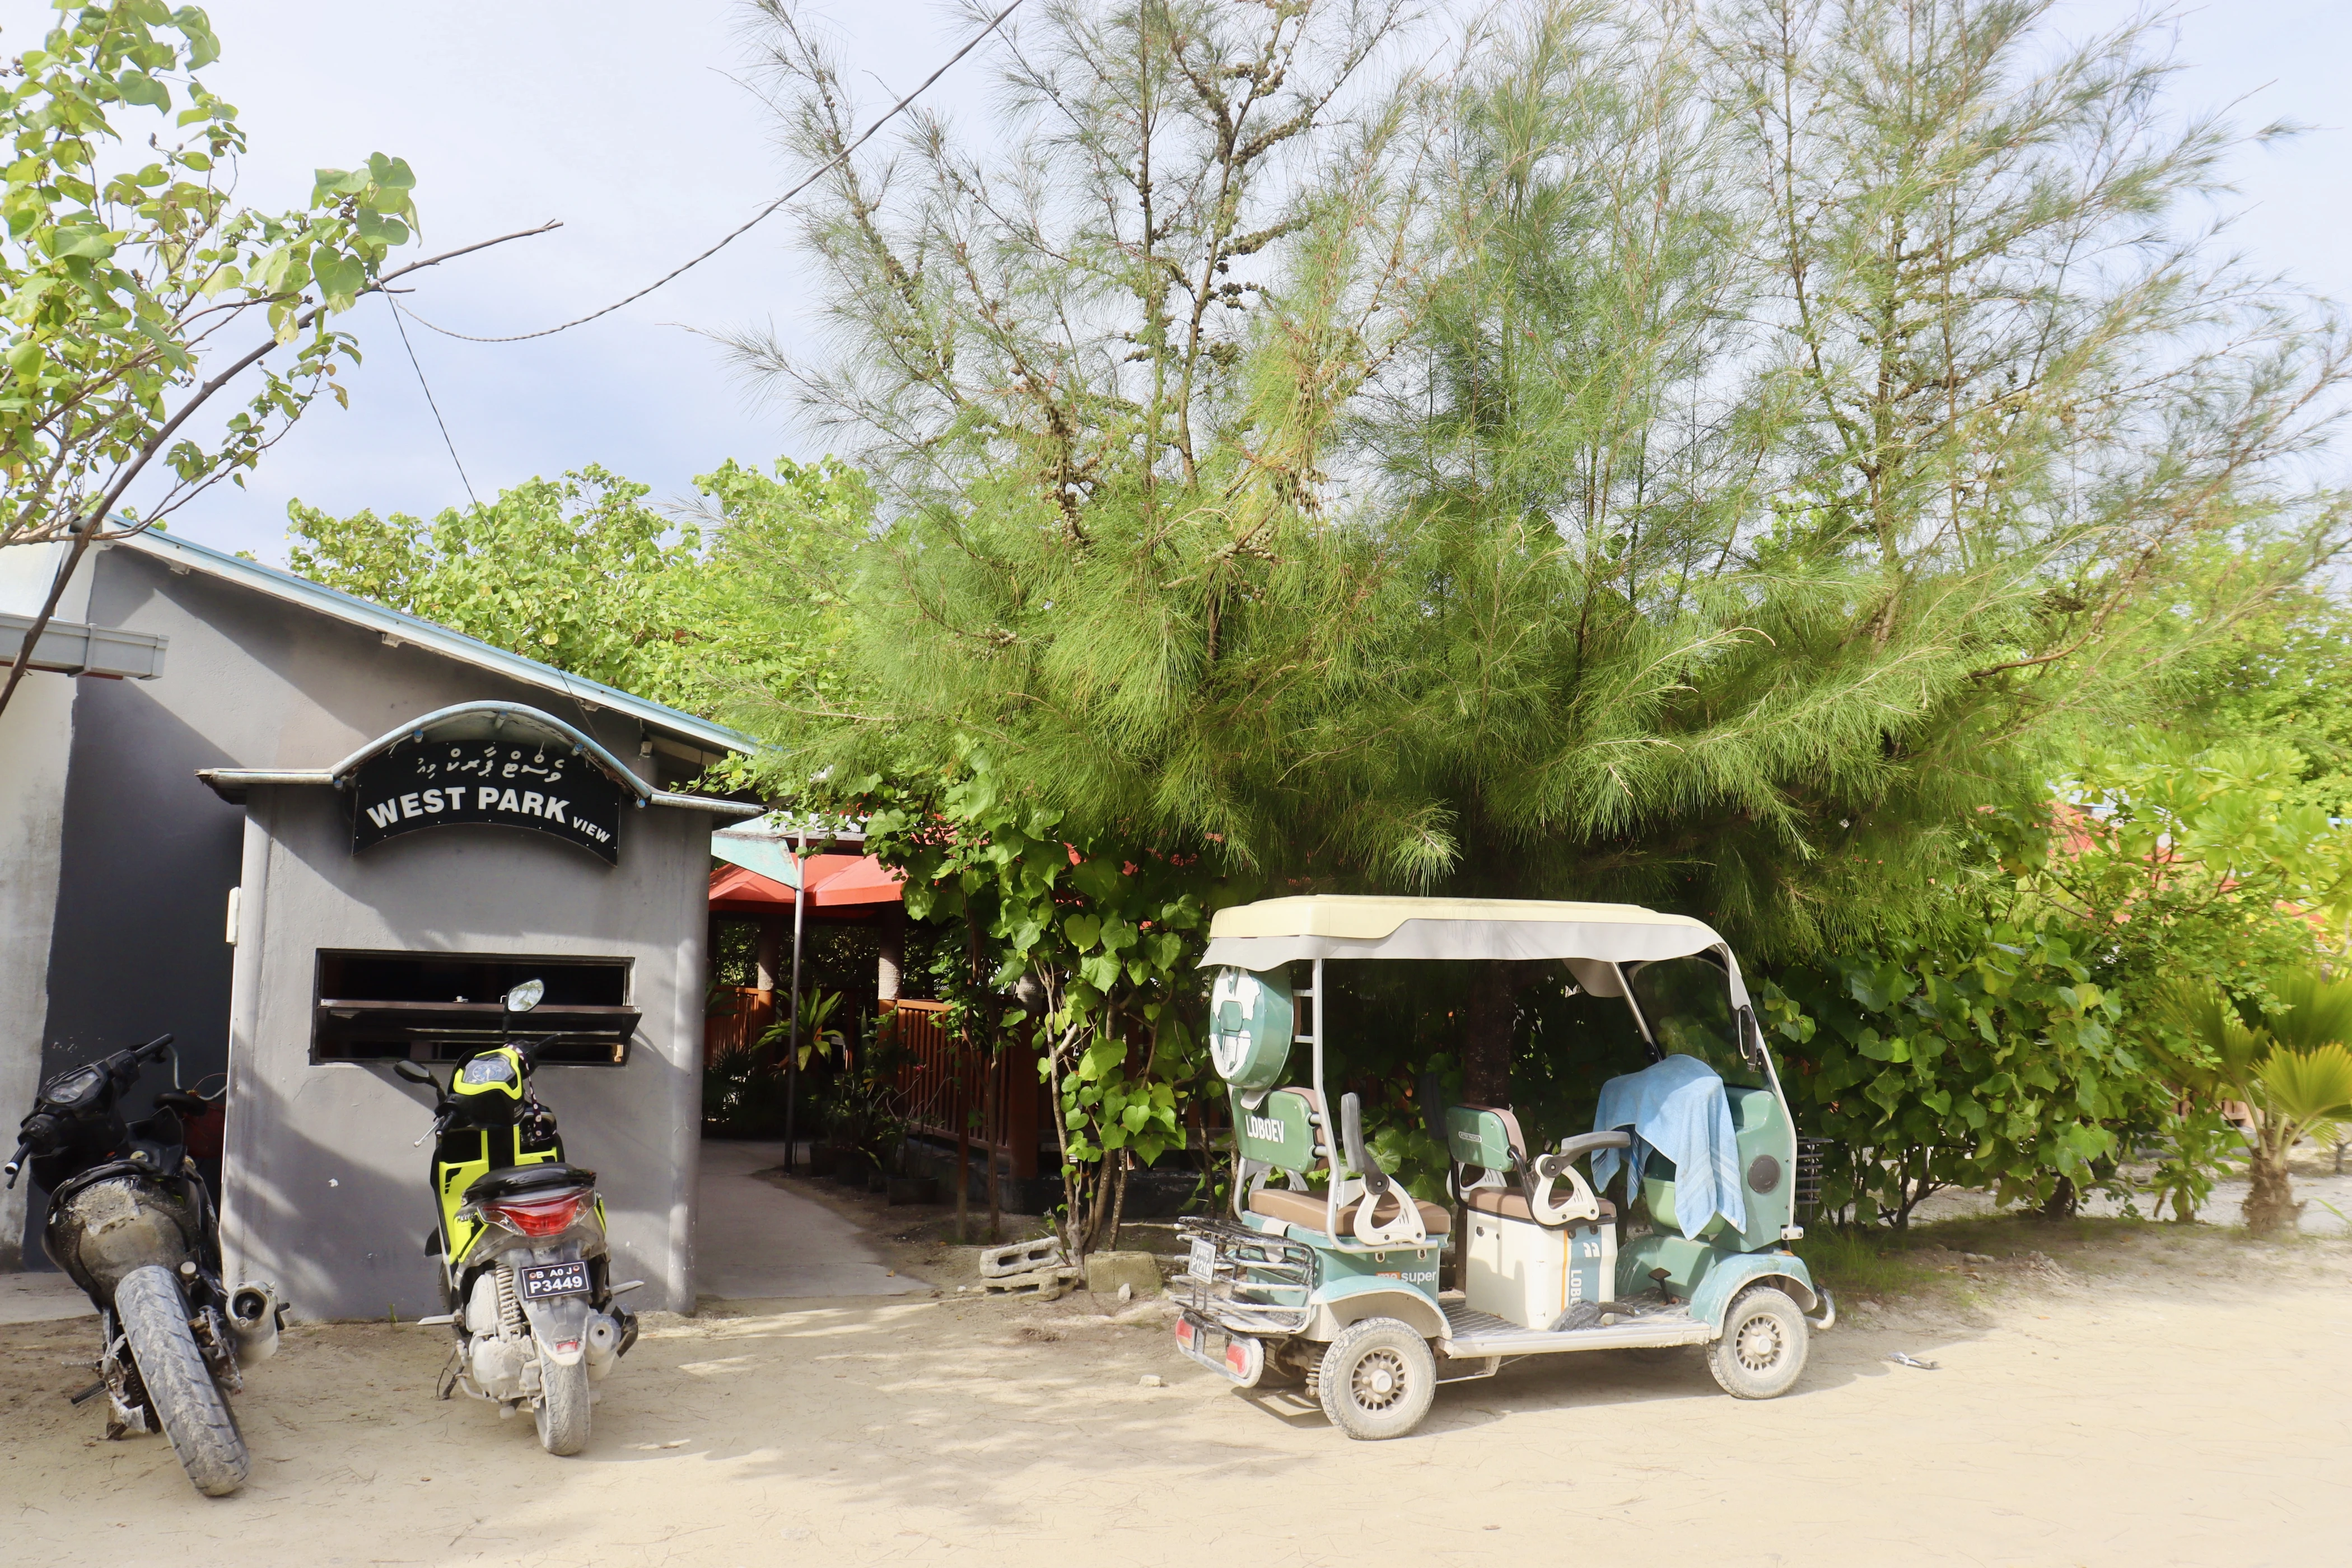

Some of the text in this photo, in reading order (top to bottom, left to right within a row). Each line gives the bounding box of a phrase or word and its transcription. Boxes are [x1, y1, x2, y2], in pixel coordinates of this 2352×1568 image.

[366, 786, 611, 843] WEST PARK VIEW
[1245, 1114, 1285, 1144] LOBOEV
[1191, 1257, 1210, 1276] P1216
[529, 1276, 583, 1294] P3449
[1401, 1271, 1437, 1285] super
